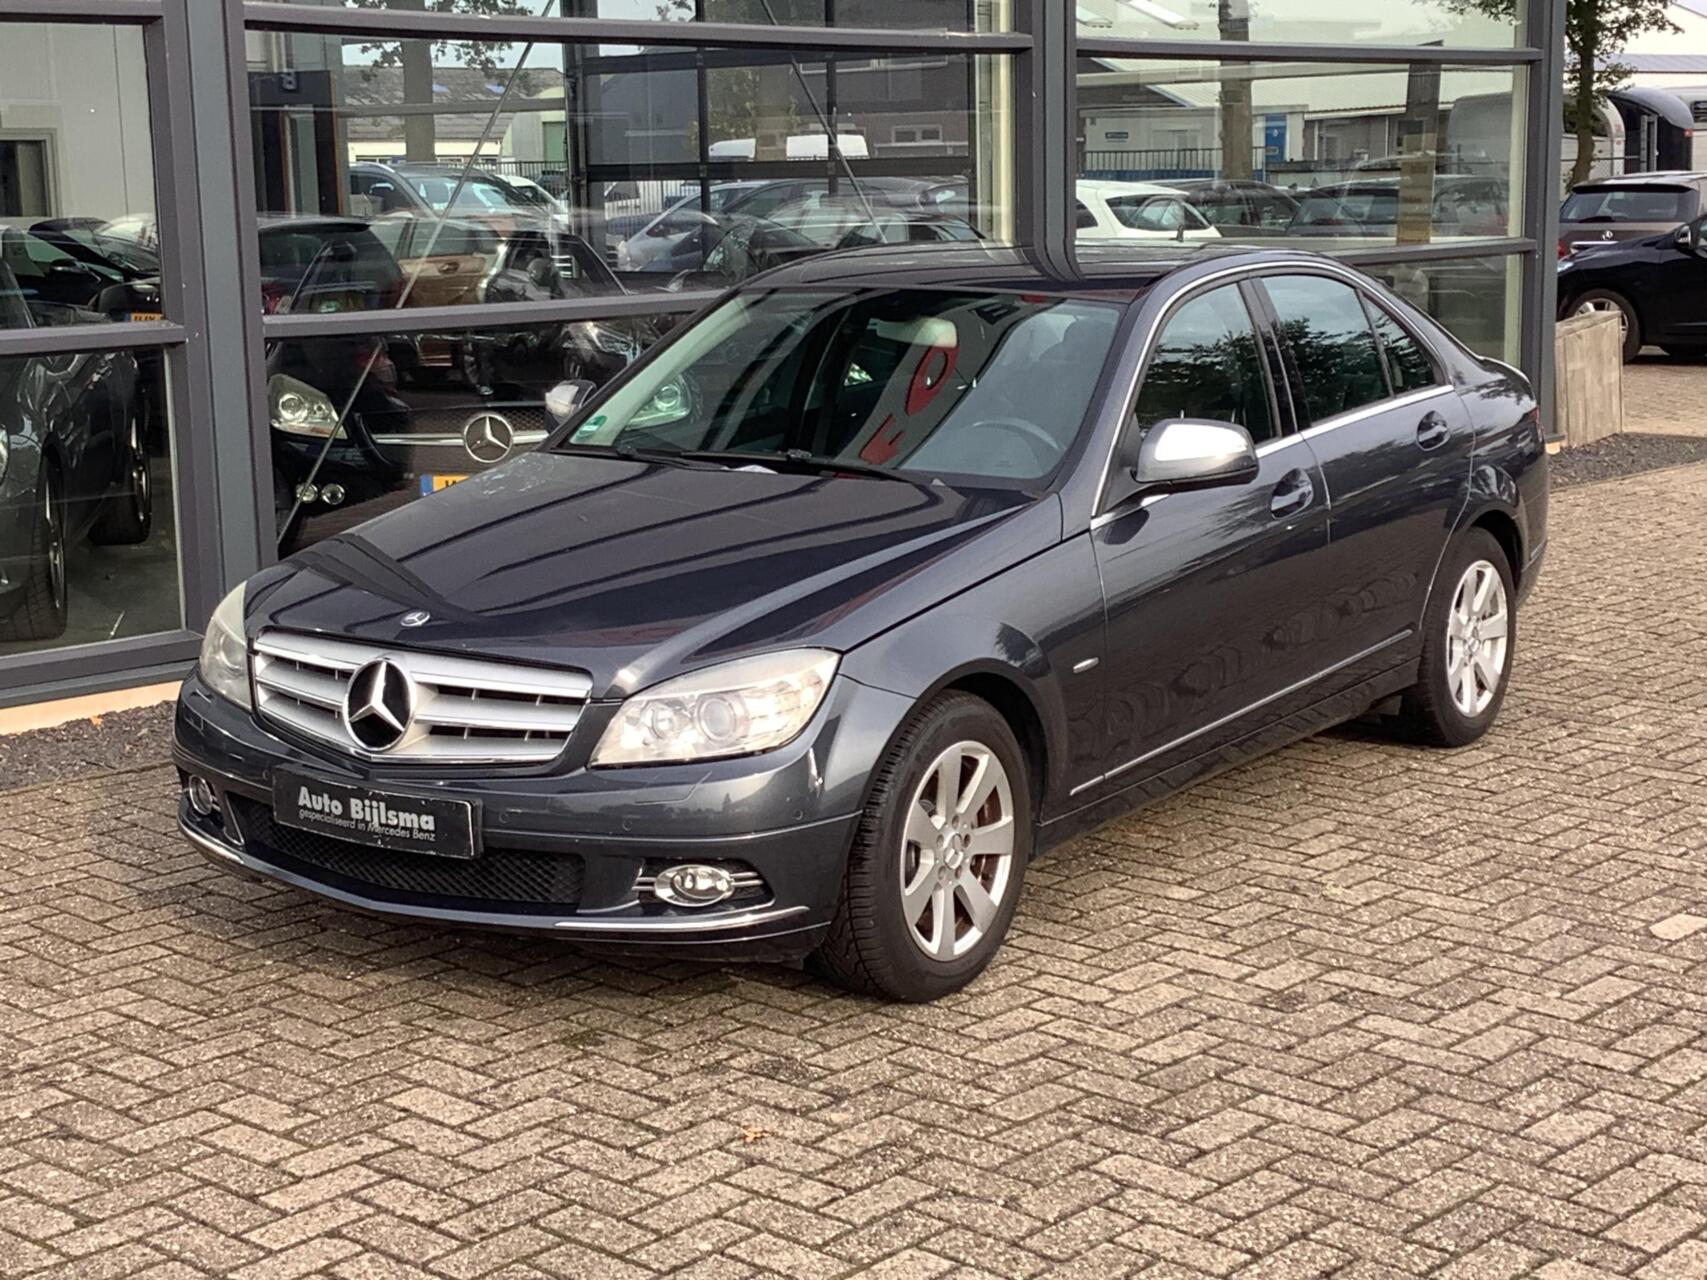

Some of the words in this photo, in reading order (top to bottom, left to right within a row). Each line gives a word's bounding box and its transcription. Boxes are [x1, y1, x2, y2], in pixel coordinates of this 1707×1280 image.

[298, 786, 343, 816] Auto
[349, 798, 435, 831] Bijlsma
[358, 820, 366, 830] in
[367, 822, 410, 838] Mercedes
[413, 829, 436, 842] Benz
